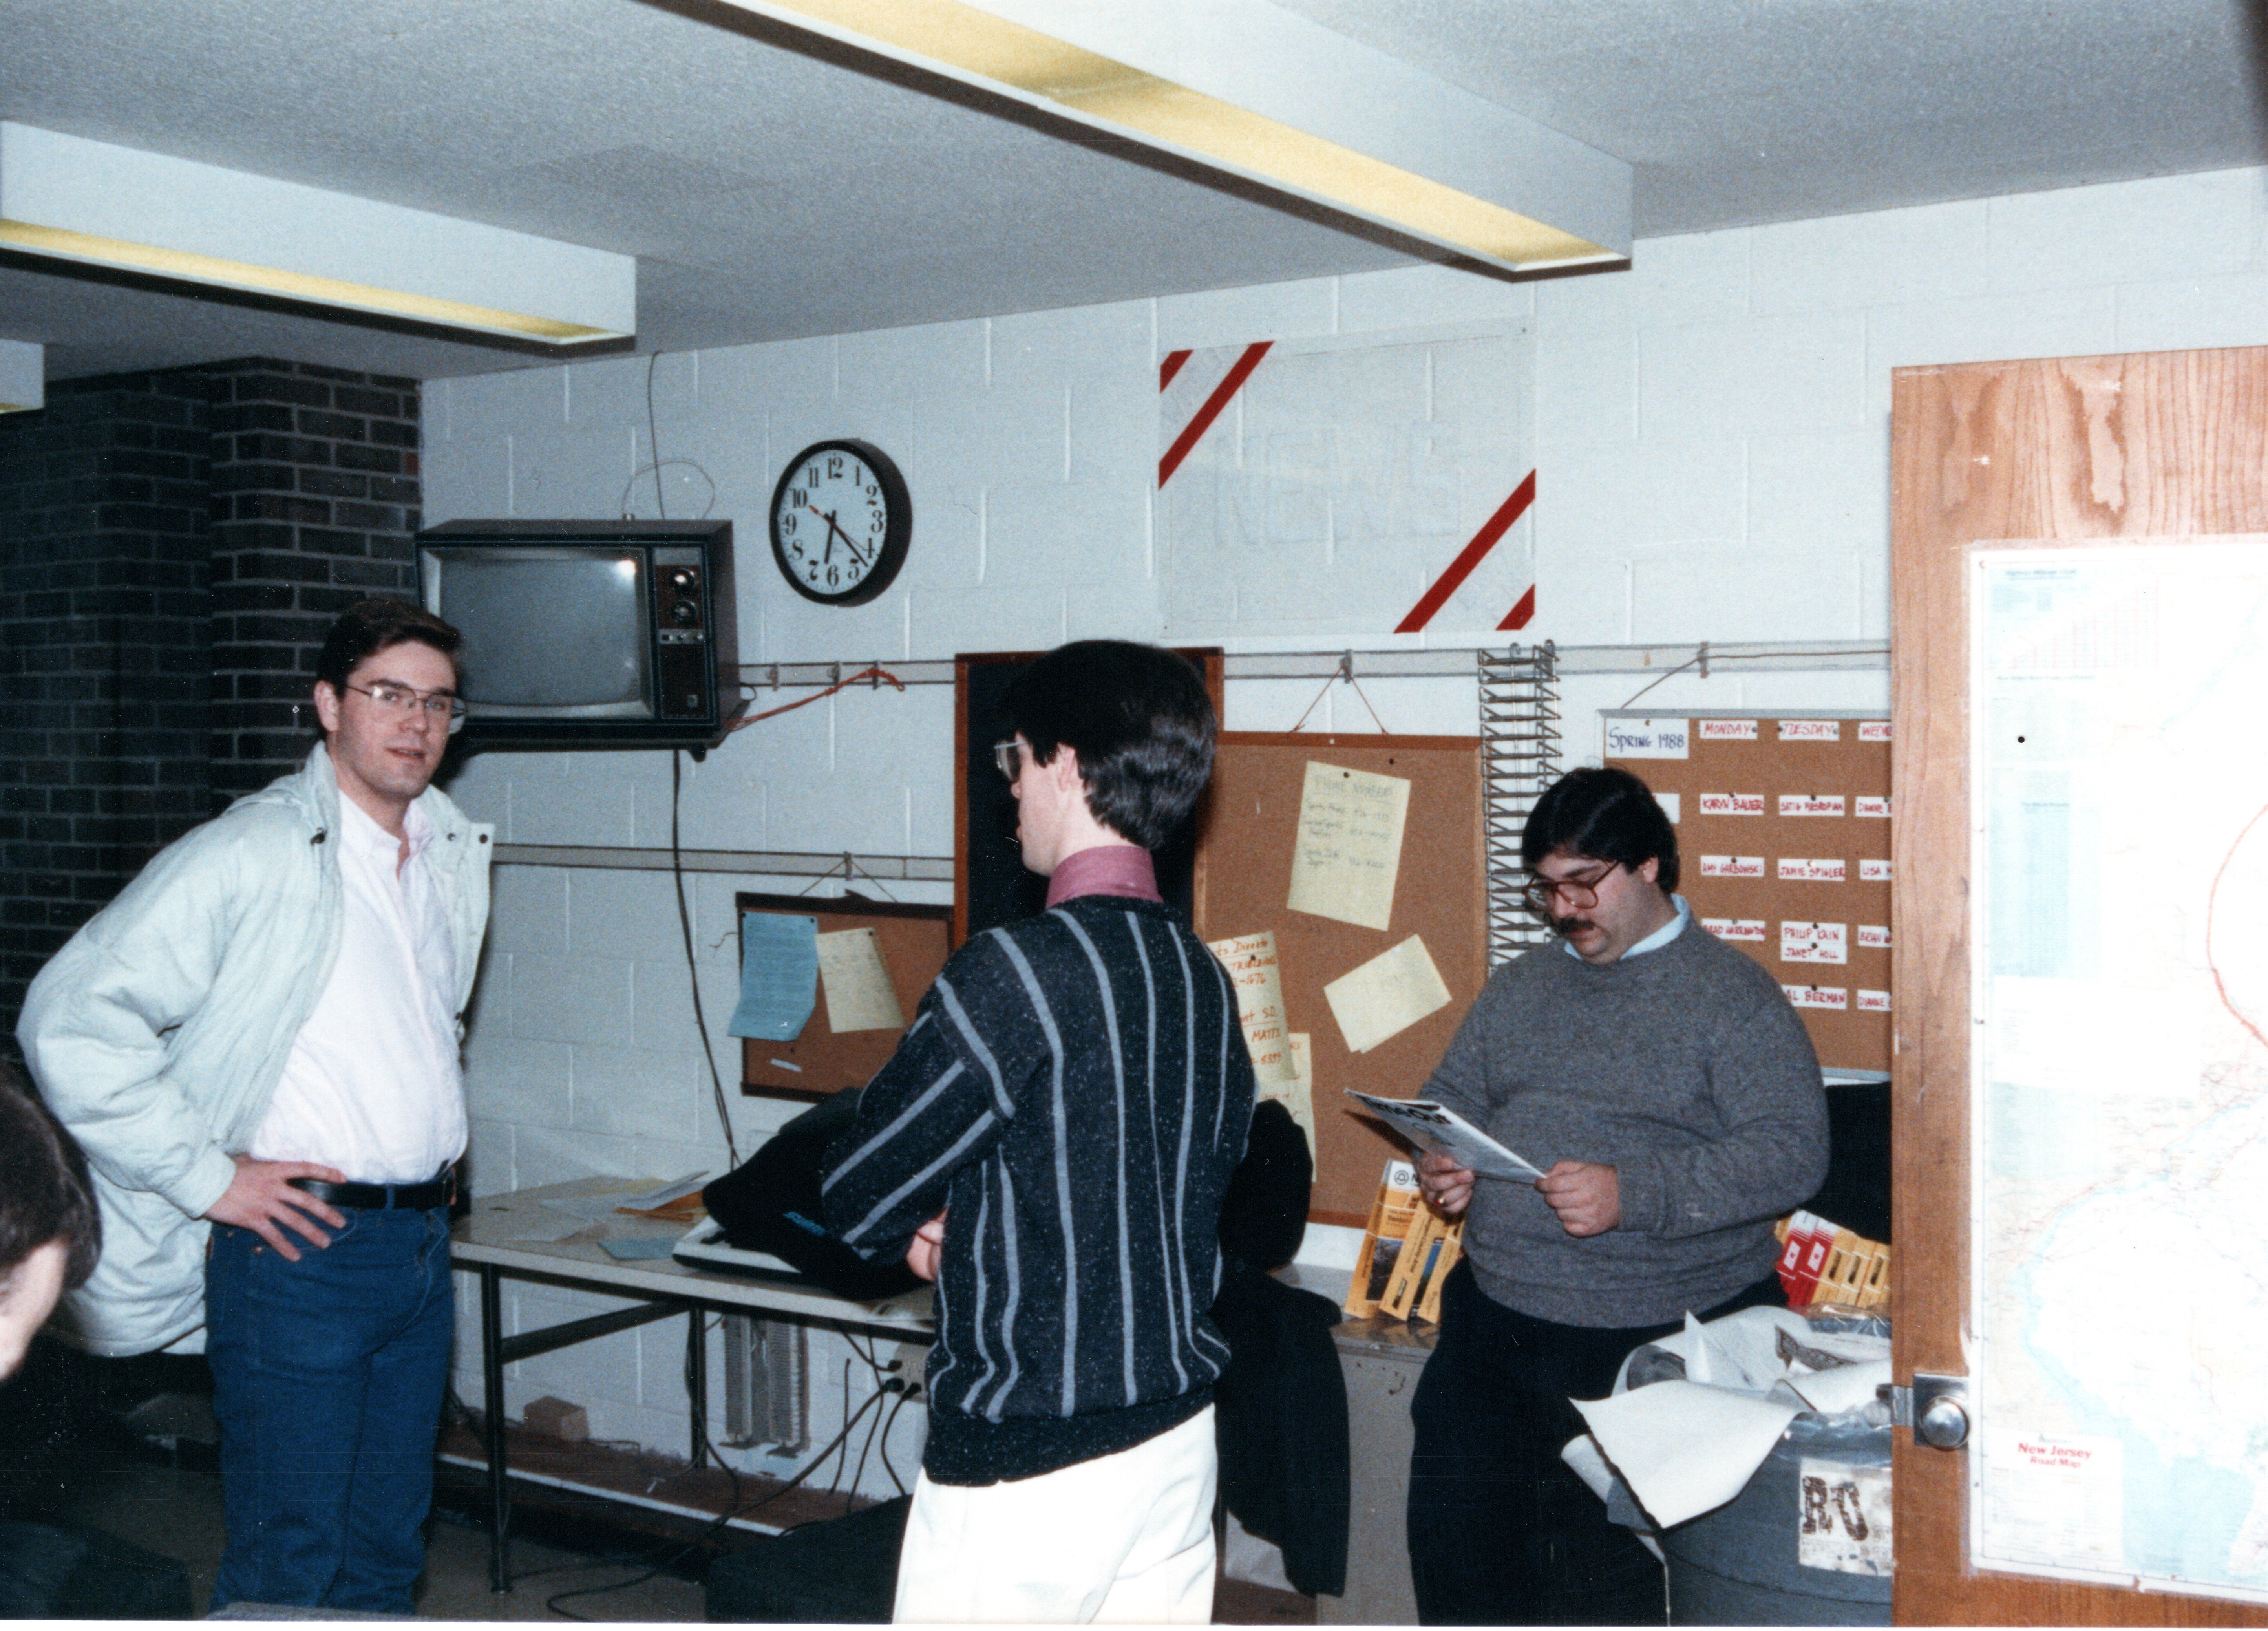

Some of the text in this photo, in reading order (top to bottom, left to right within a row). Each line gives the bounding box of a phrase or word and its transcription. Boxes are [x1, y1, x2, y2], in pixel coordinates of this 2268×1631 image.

[809, 467, 819, 488] 11
[828, 457, 843, 479] 12
[856, 466, 860, 486] 1
[792, 488, 807, 508] 10
[866, 485, 877, 506] 2
[784, 513, 797, 535] 9
[871, 510, 883, 533] 3
[788, 539, 803, 560] 8
[864, 538, 875, 558] 4
[809, 560, 819, 581] 7
[827, 565, 839, 587] 6
[848, 558, 859, 580] 5
[1704, 722, 1751, 735] MONDAY
[1783, 723, 1834, 737] TUESDAY
[1658, 734, 1684, 749] 1988
[1733, 799, 1764, 810] BAUER
[1780, 866, 1806, 876] JAMIE
[1863, 867, 1881, 876] LISA
[1784, 927, 1813, 939] PHILIP
[1805, 990, 1845, 1004] BERMAN
[1415, 1237, 1427, 1257] County
[1410, 1258, 1418, 1273] Area
[2018, 1442, 2091, 1459] New Jersey
[2030, 1456, 2080, 1468] Road Map
